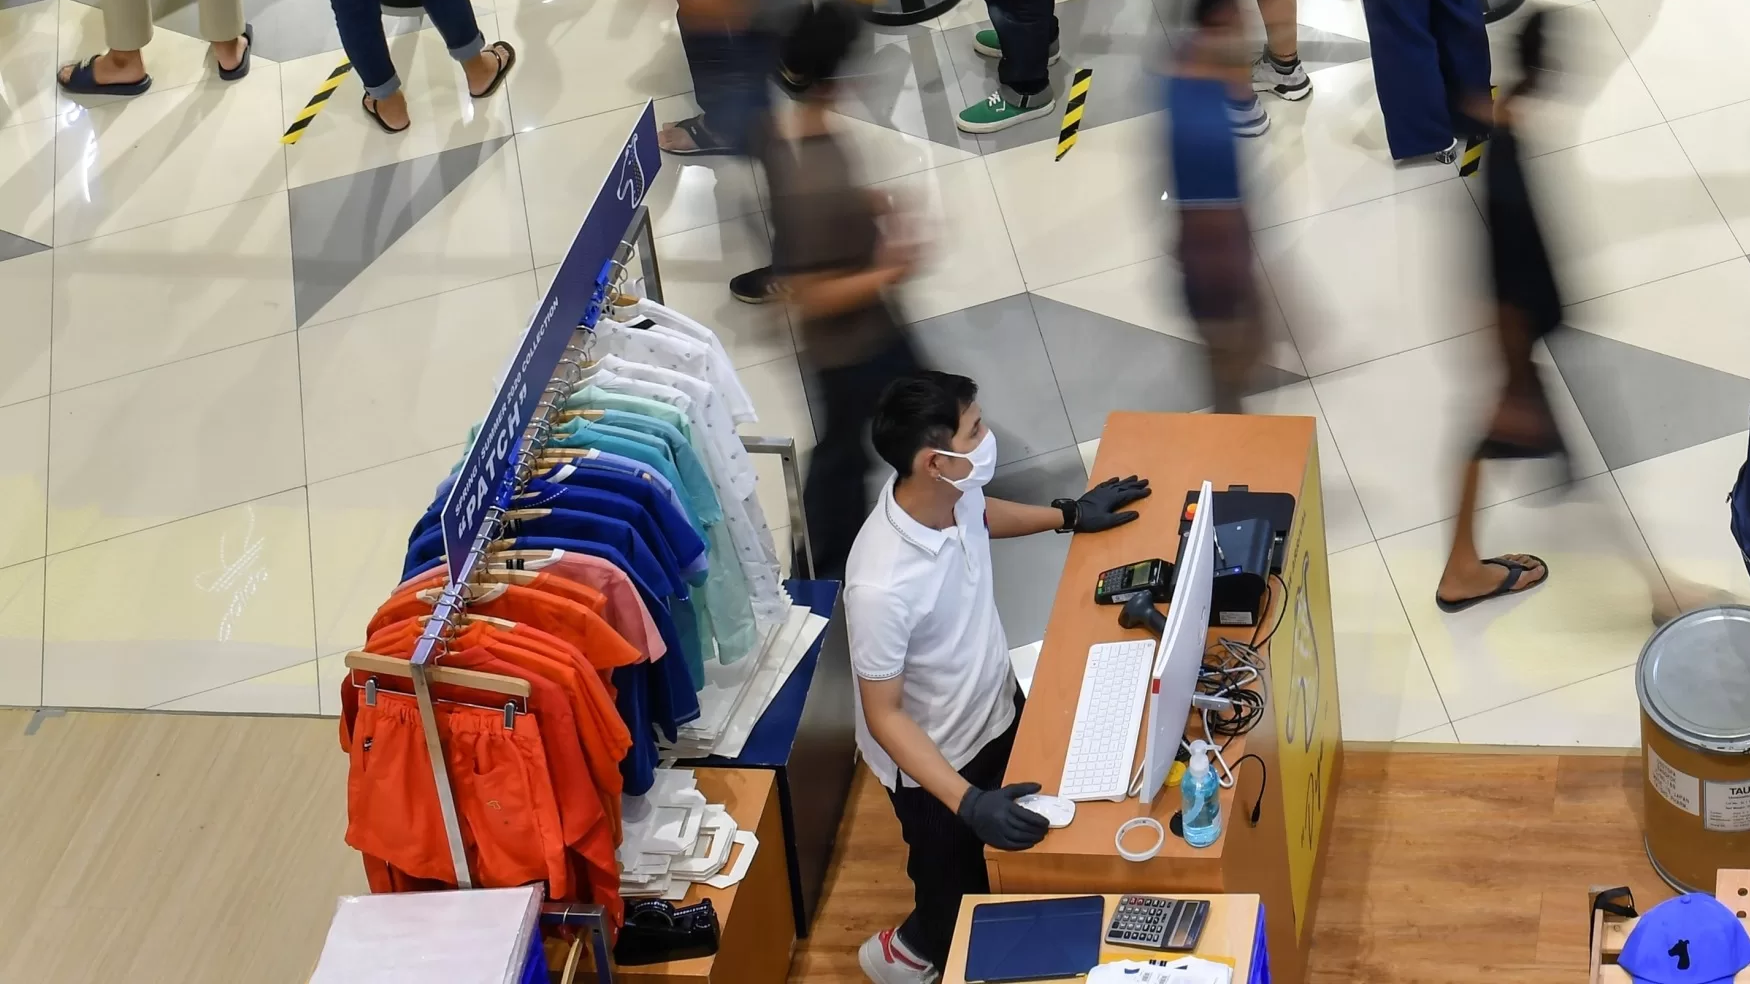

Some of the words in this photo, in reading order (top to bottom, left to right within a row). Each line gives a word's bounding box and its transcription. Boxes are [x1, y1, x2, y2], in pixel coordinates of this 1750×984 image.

[455, 462, 478, 516] SPRING
[480, 404, 507, 459] SUMMER
[507, 372, 521, 400] 2020
[521, 296, 559, 372] COLLECTION
